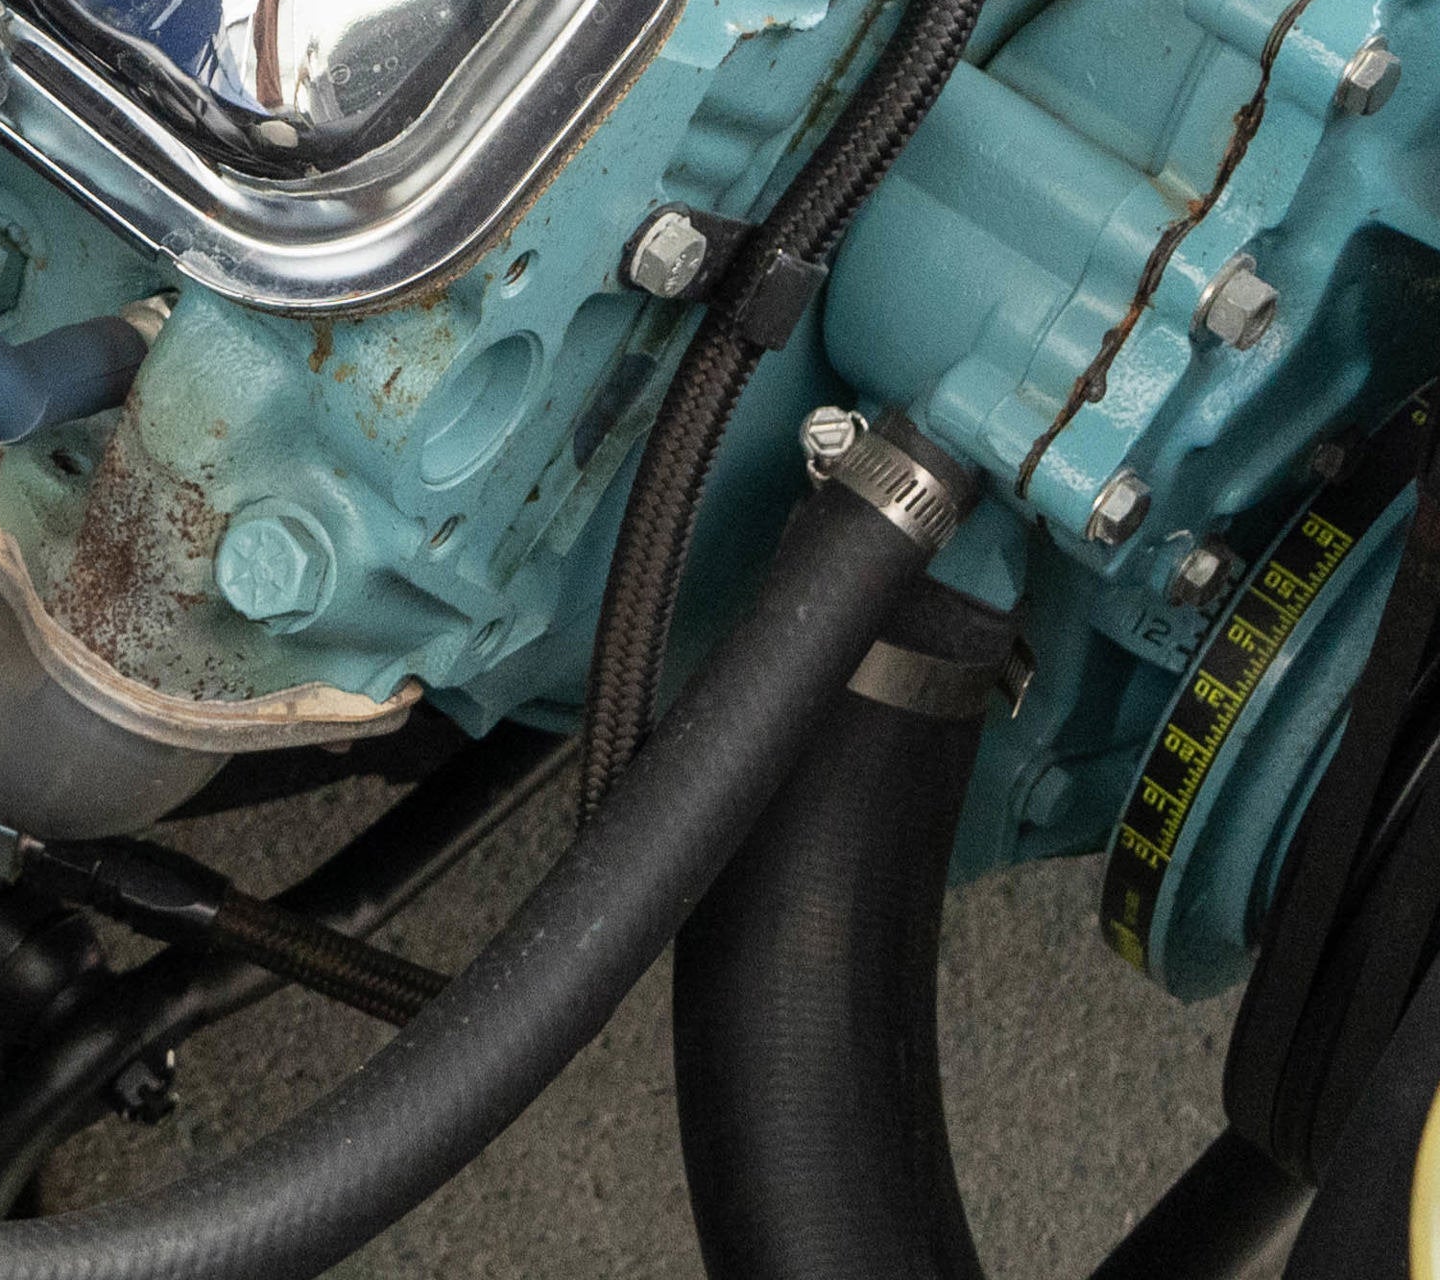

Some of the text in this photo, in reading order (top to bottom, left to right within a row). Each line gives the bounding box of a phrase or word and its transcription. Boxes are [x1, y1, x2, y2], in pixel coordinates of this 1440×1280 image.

[1300, 517, 1336, 547] 60
[1261, 568, 1298, 599] 50
[1130, 608, 1172, 648] 12
[1225, 621, 1261, 652] 40
[1191, 676, 1228, 707] 30
[1161, 730, 1197, 761] 20
[1140, 783, 1169, 814] 10
[1118, 828, 1162, 869] TDC
